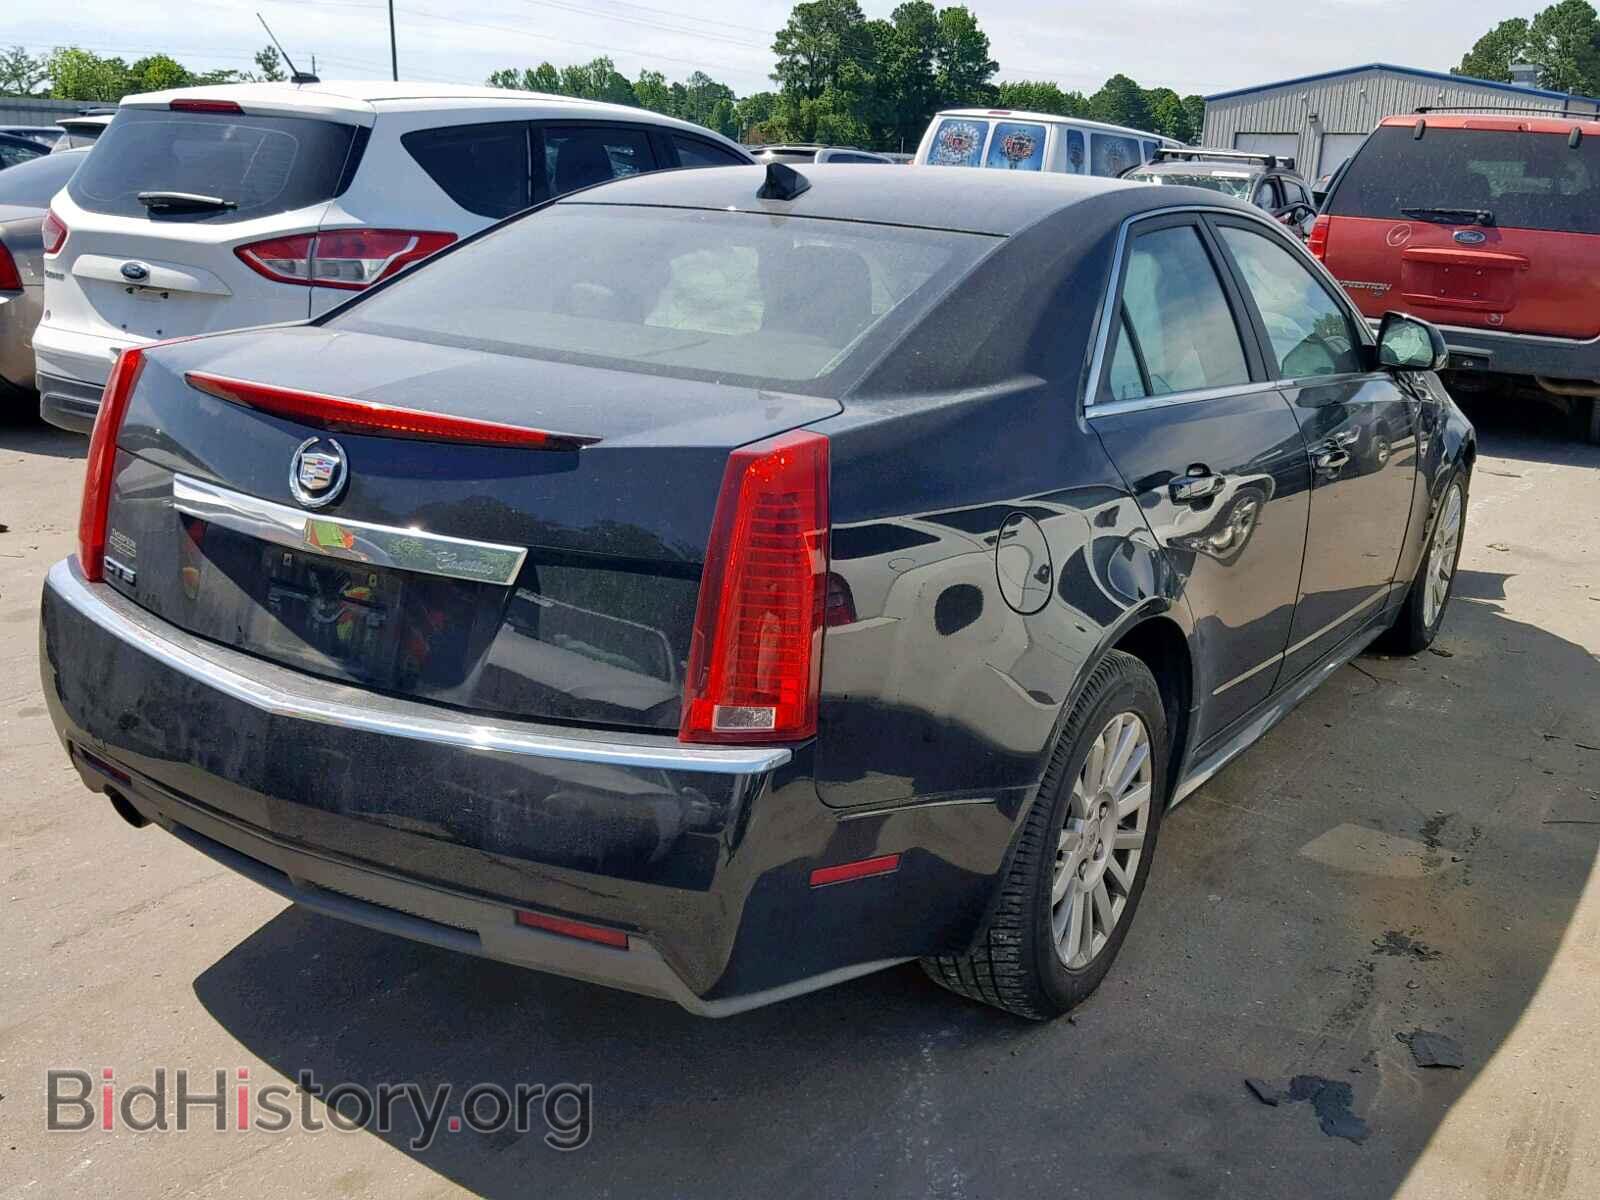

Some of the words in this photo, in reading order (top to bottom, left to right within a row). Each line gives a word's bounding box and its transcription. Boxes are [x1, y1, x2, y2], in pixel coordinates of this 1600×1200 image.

[1458, 231, 1480, 241] Ford
[104, 555, 136, 586] CTS
[436, 552, 494, 575] Cadillac
